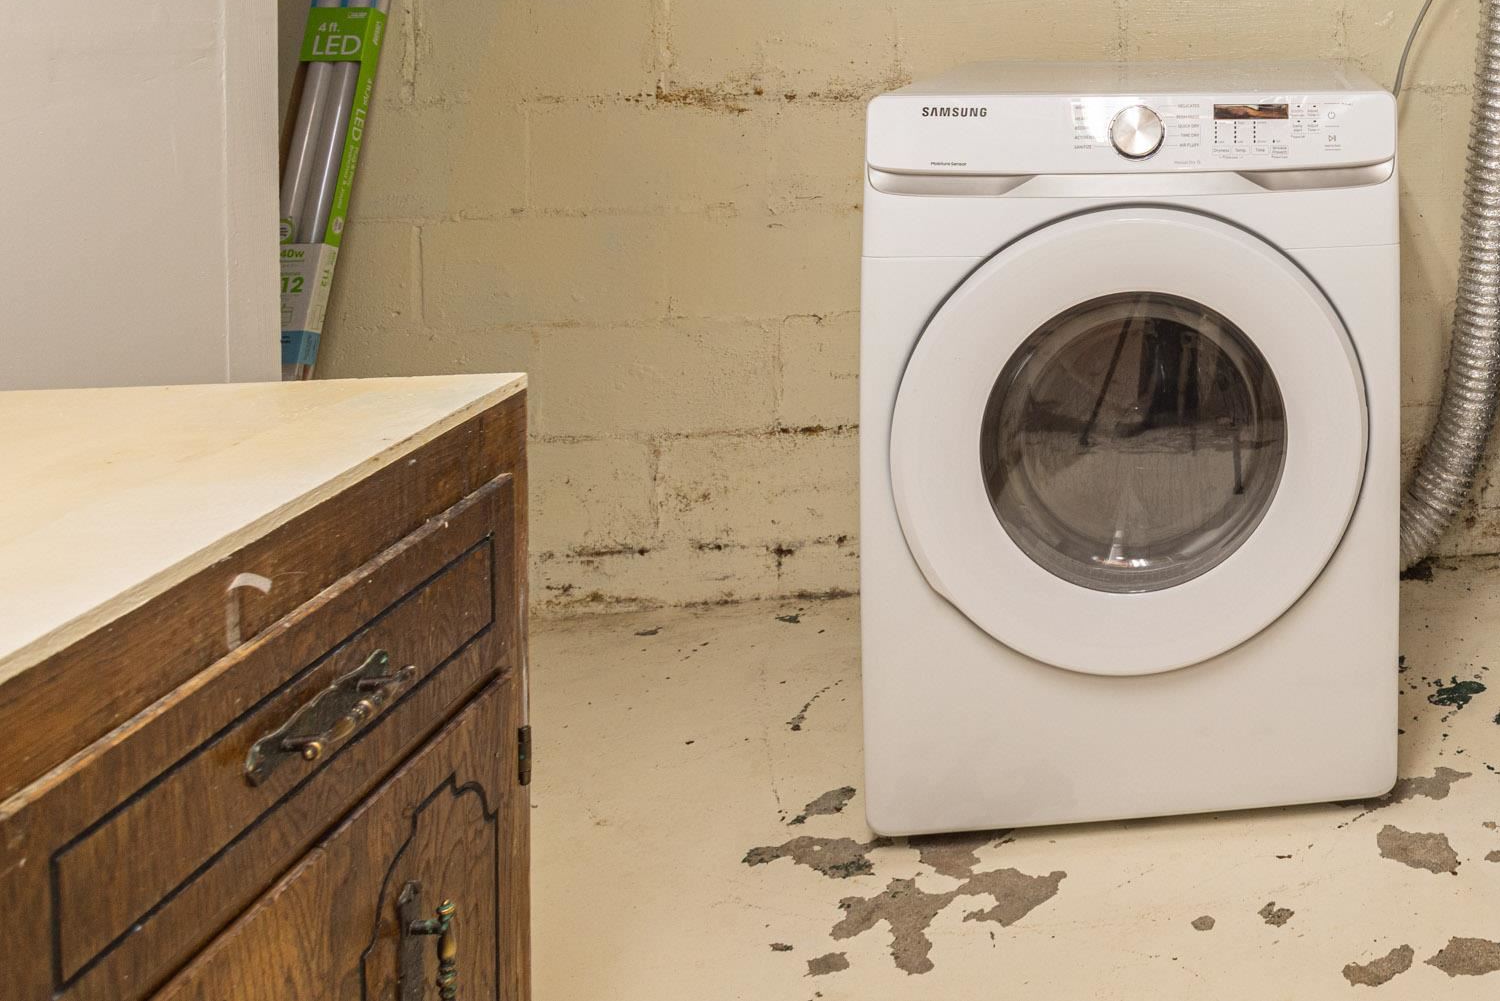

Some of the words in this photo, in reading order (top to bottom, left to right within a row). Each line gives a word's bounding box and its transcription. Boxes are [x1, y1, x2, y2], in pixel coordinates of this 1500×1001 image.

[318, 22, 327, 32] 4
[328, 22, 341, 33] ft.
[312, 34, 362, 56] LED
[921, 106, 988, 117] SAMSUNG
[351, 108, 366, 142] LED
